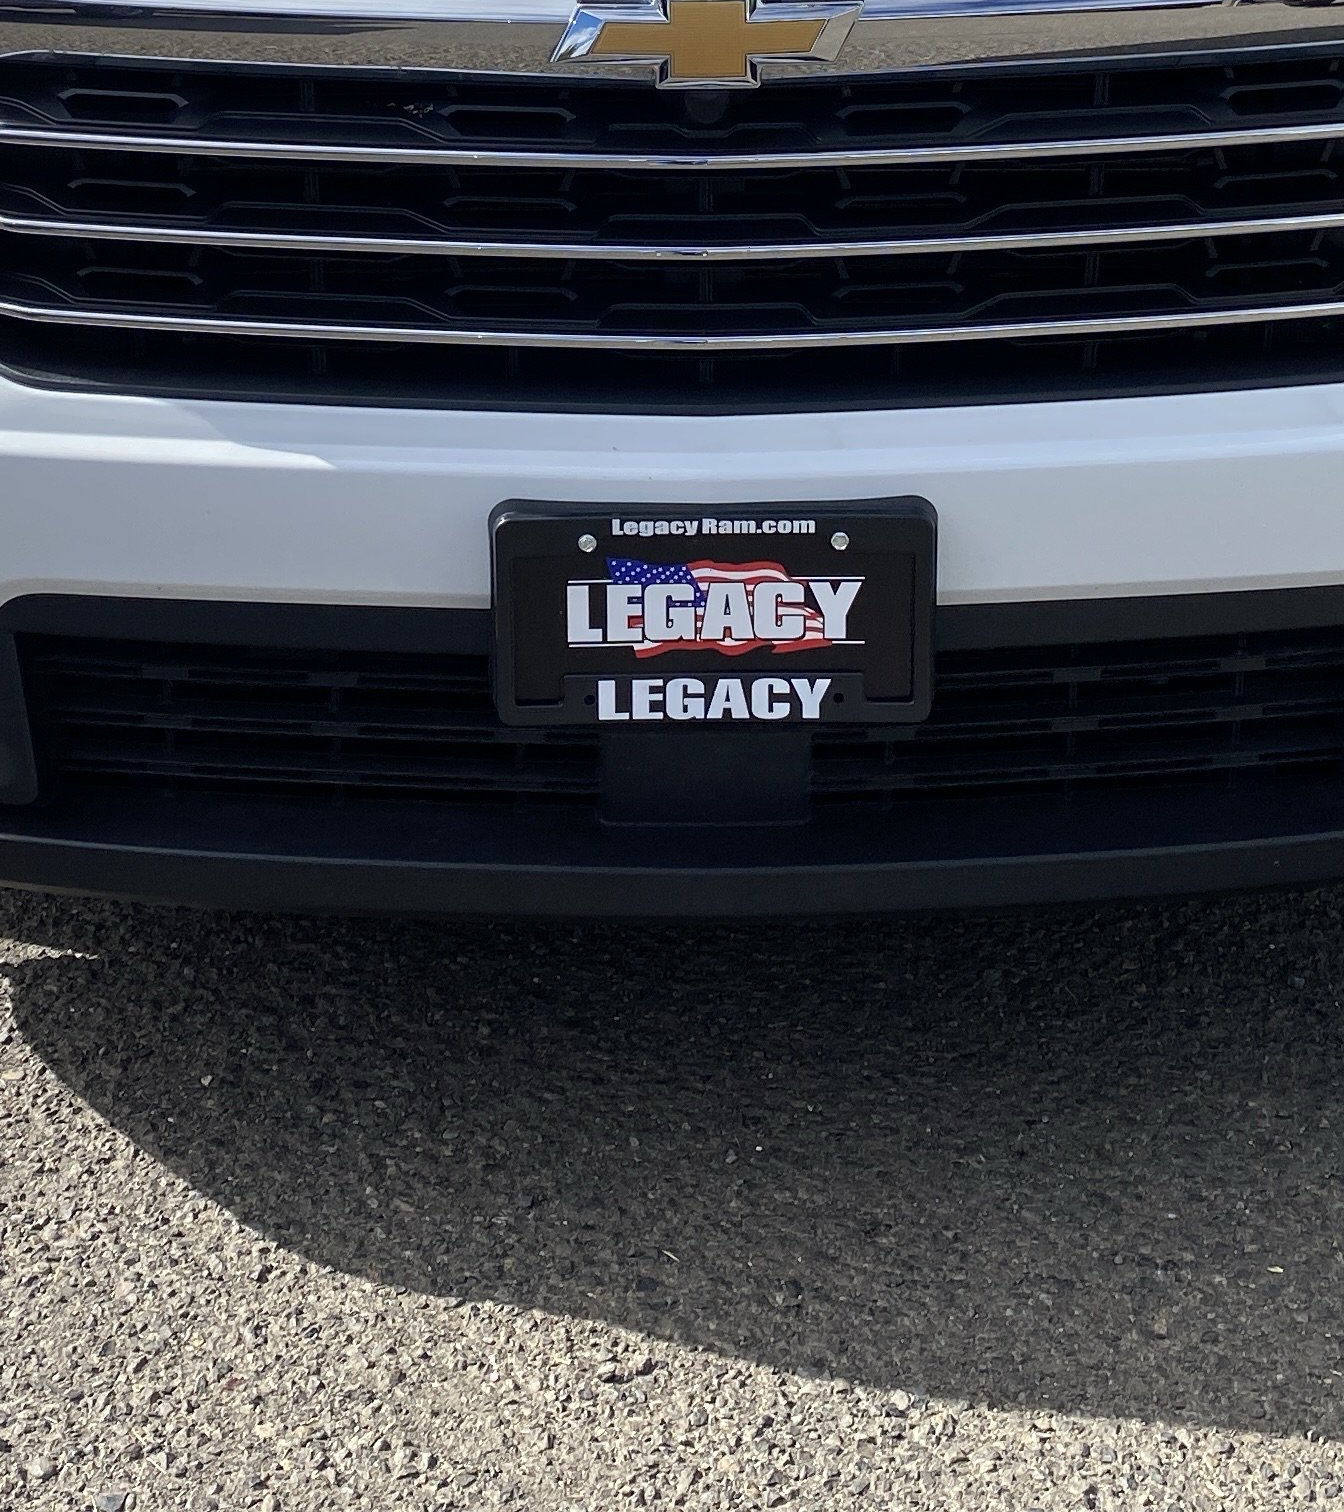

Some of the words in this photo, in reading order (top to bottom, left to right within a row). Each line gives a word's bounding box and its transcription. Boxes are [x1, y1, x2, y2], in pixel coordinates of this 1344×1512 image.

[612, 518, 698, 536] Legacy
[702, 518, 816, 535] Ram.com
[566, 581, 862, 643] LEGACY
[597, 678, 832, 720] LEGACY
